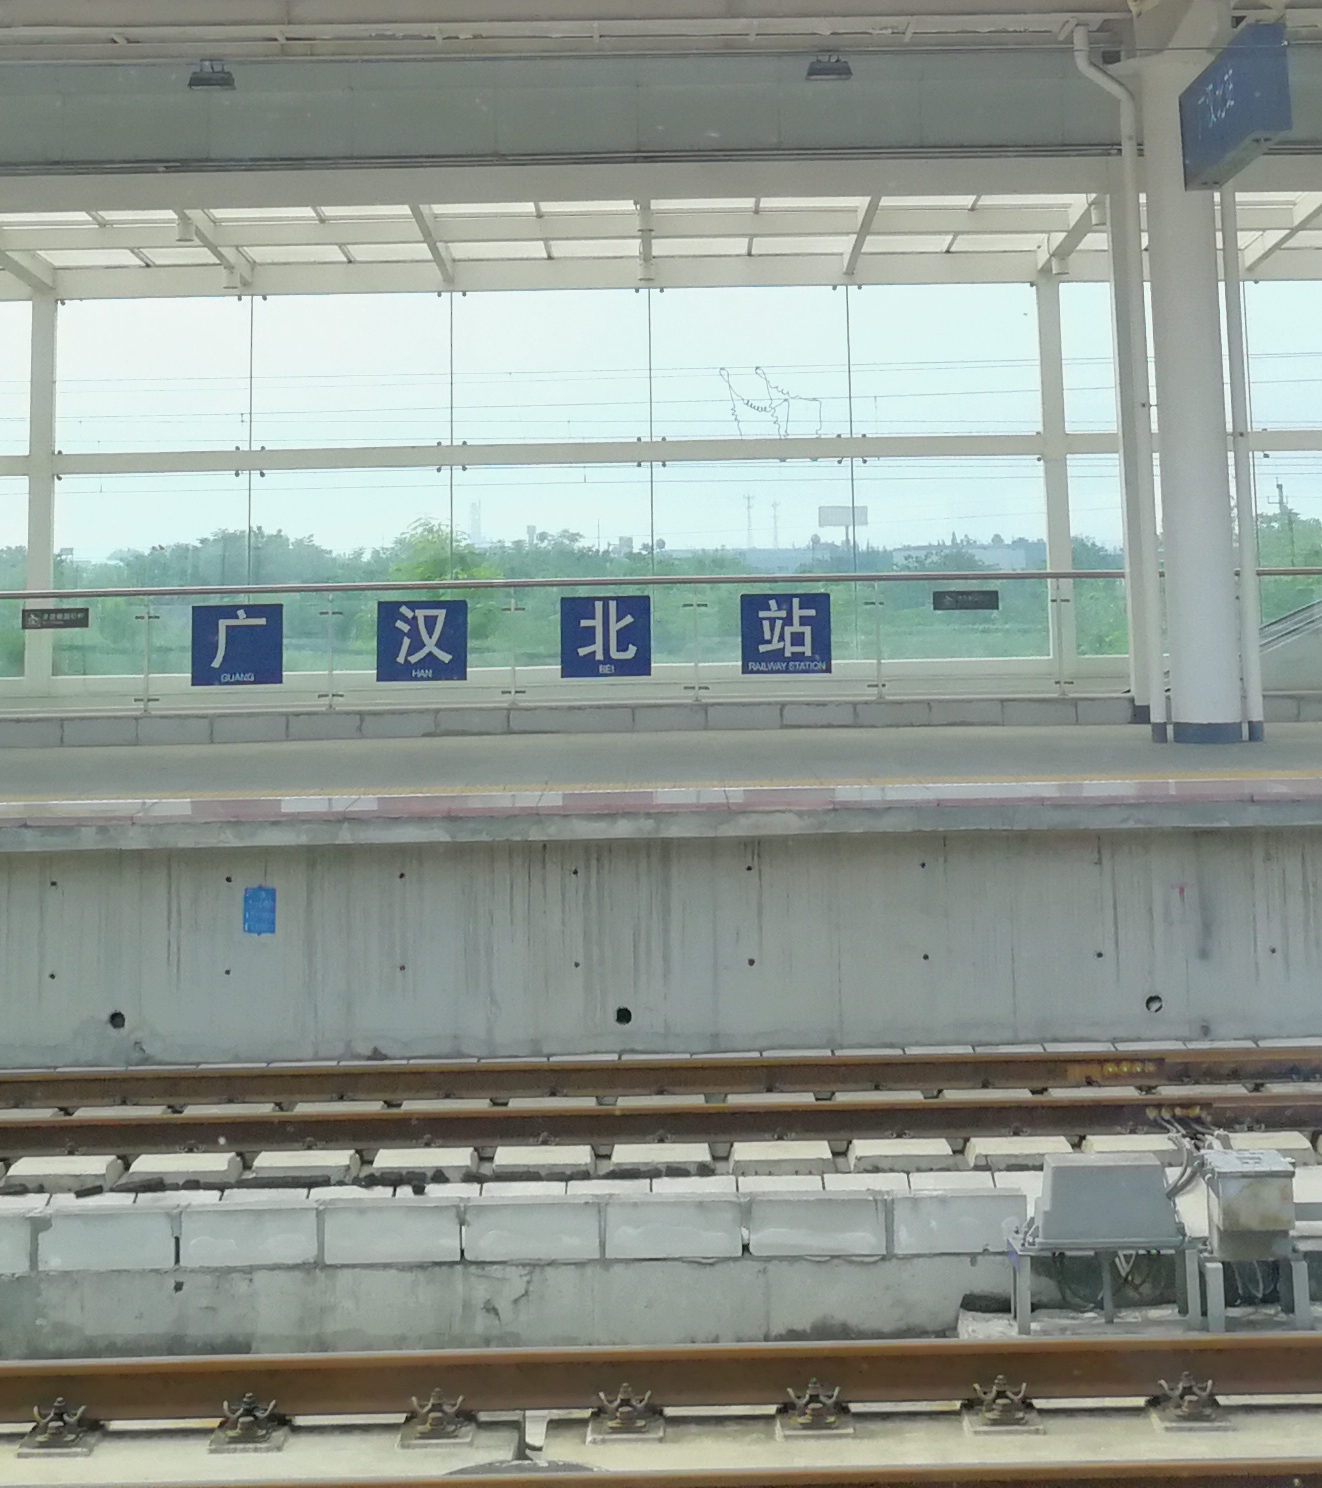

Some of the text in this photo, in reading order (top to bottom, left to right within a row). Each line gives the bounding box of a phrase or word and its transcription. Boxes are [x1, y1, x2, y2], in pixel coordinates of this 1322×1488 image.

[210, 597, 817, 669] 广 汉 北 站
[747, 661, 827, 672] RAILWAY STATION
[220, 672, 255, 683] GUANG
[411, 668, 434, 679] HAN
